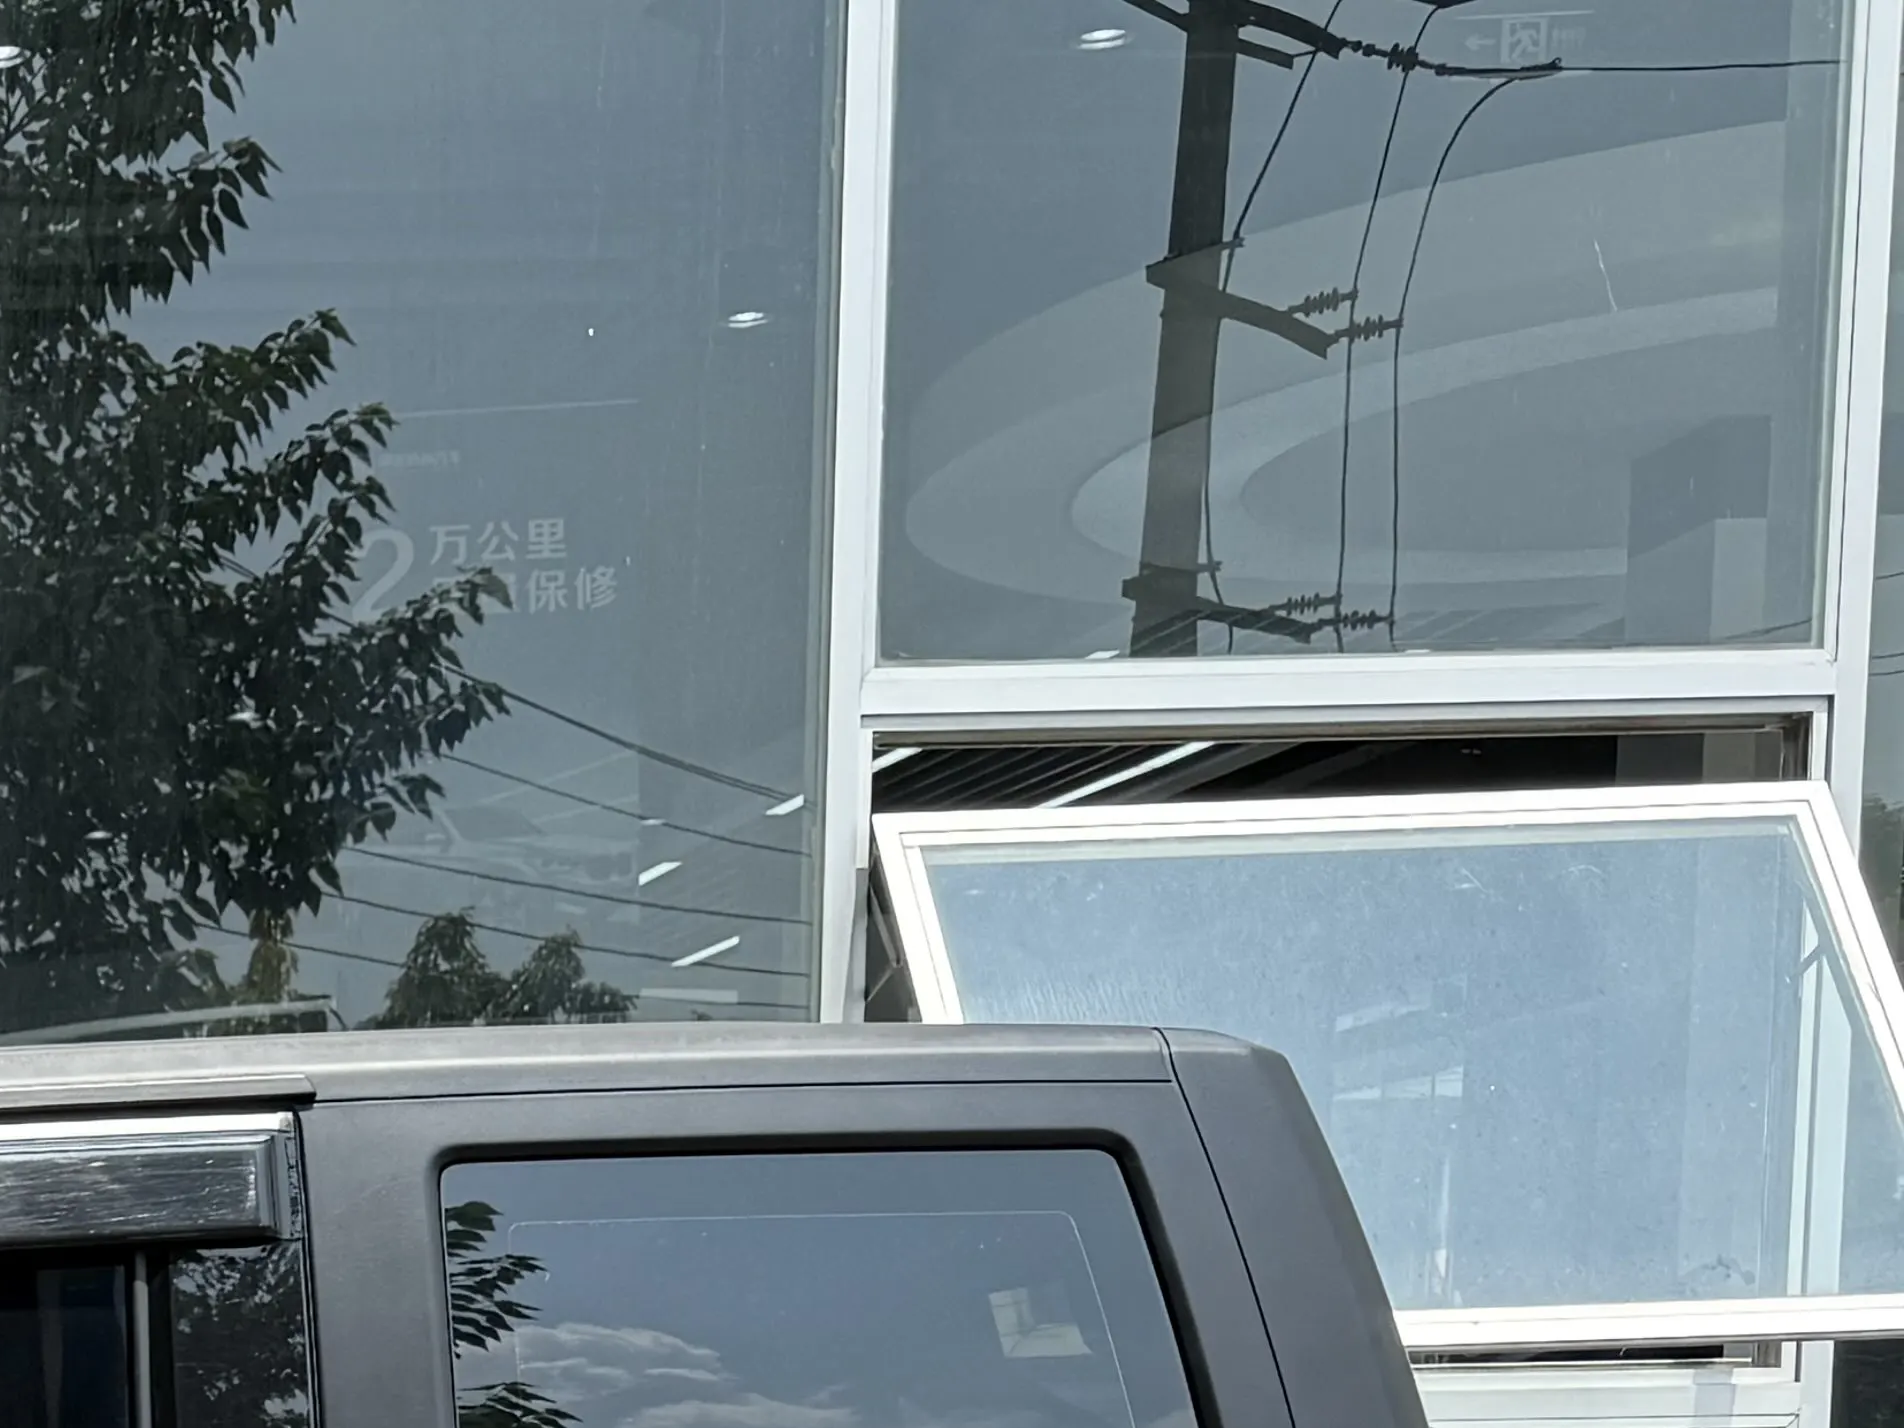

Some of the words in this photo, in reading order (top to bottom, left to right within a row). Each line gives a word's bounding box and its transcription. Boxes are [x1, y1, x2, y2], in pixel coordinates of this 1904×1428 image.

[428, 517, 567, 566] 万公里
[432, 565, 618, 615] 保修
